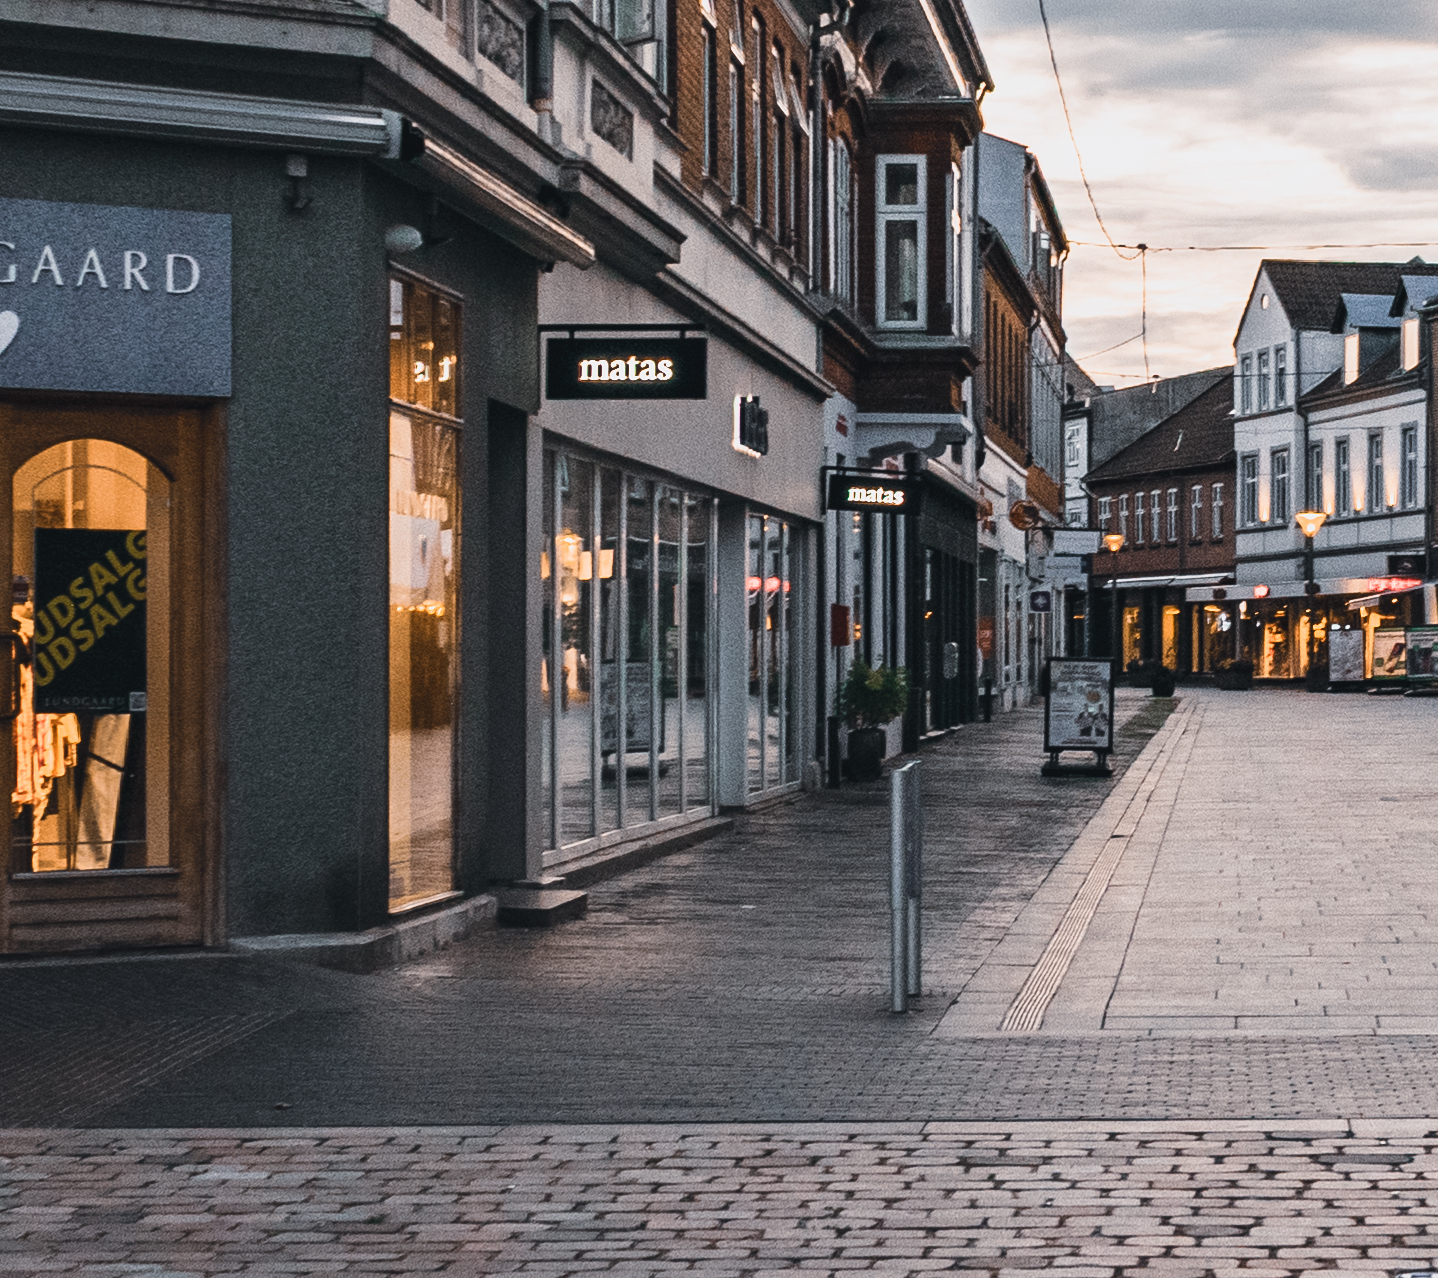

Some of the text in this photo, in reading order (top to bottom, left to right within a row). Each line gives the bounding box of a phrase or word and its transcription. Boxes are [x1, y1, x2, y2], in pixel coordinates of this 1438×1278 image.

[578, 355, 674, 382] matas
[847, 486, 906, 506] matas
[35, 530, 147, 644] UDSALG
[35, 568, 147, 686] UDSALG
